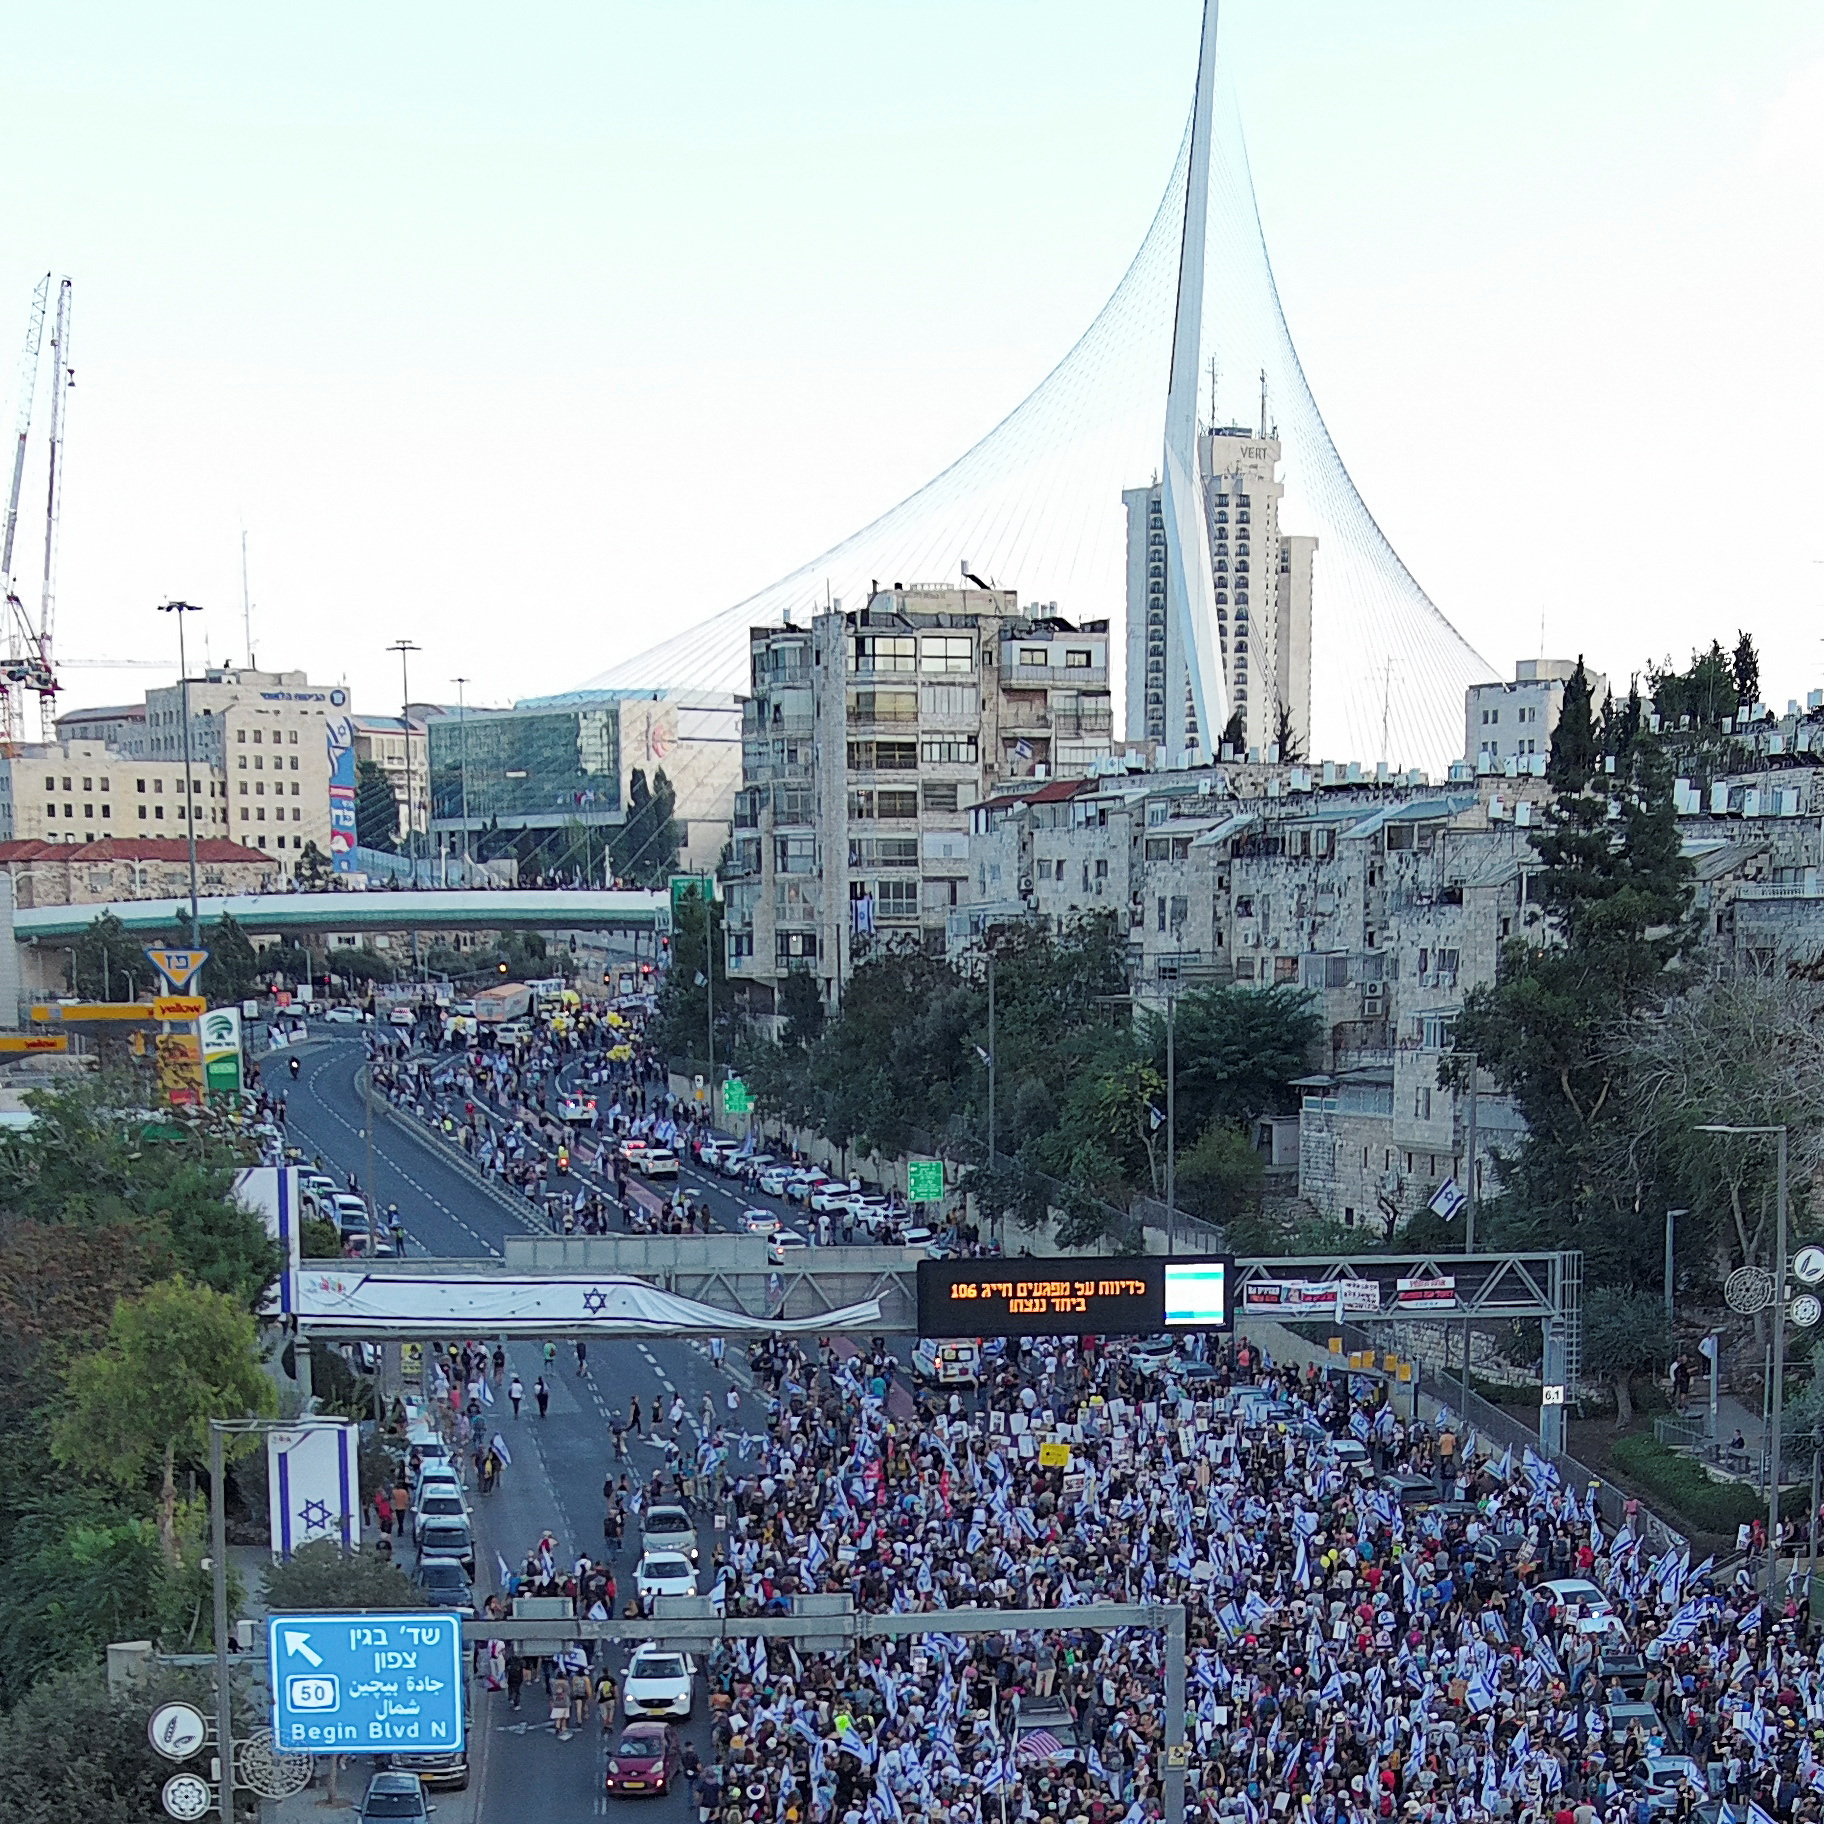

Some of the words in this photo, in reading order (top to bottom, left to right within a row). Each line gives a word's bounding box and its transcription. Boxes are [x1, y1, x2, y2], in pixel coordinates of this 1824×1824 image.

[165, 954, 189, 969] פז
[951, 1283, 977, 1299] 106
[981, 1283, 1012, 1298] חייג
[1016, 1282, 1070, 1297] מפגעים
[1074, 1281, 1094, 1296] על
[1098, 1280, 1145, 1296] לדיווח
[1050, 1297, 1087, 1312] ביחד
[1546, 1390, 1560, 1400] 6.1
[349, 1628, 388, 1651] בגין
[375, 1651, 417, 1673] צפון
[301, 1685, 325, 1701] 50
[406, 1675, 445, 1696] جادة
[375, 1699, 420, 1720] شمال
[291, 1722, 357, 1744] Begin
[369, 1721, 419, 1739] Blvd
[431, 1721, 446, 1738] N
